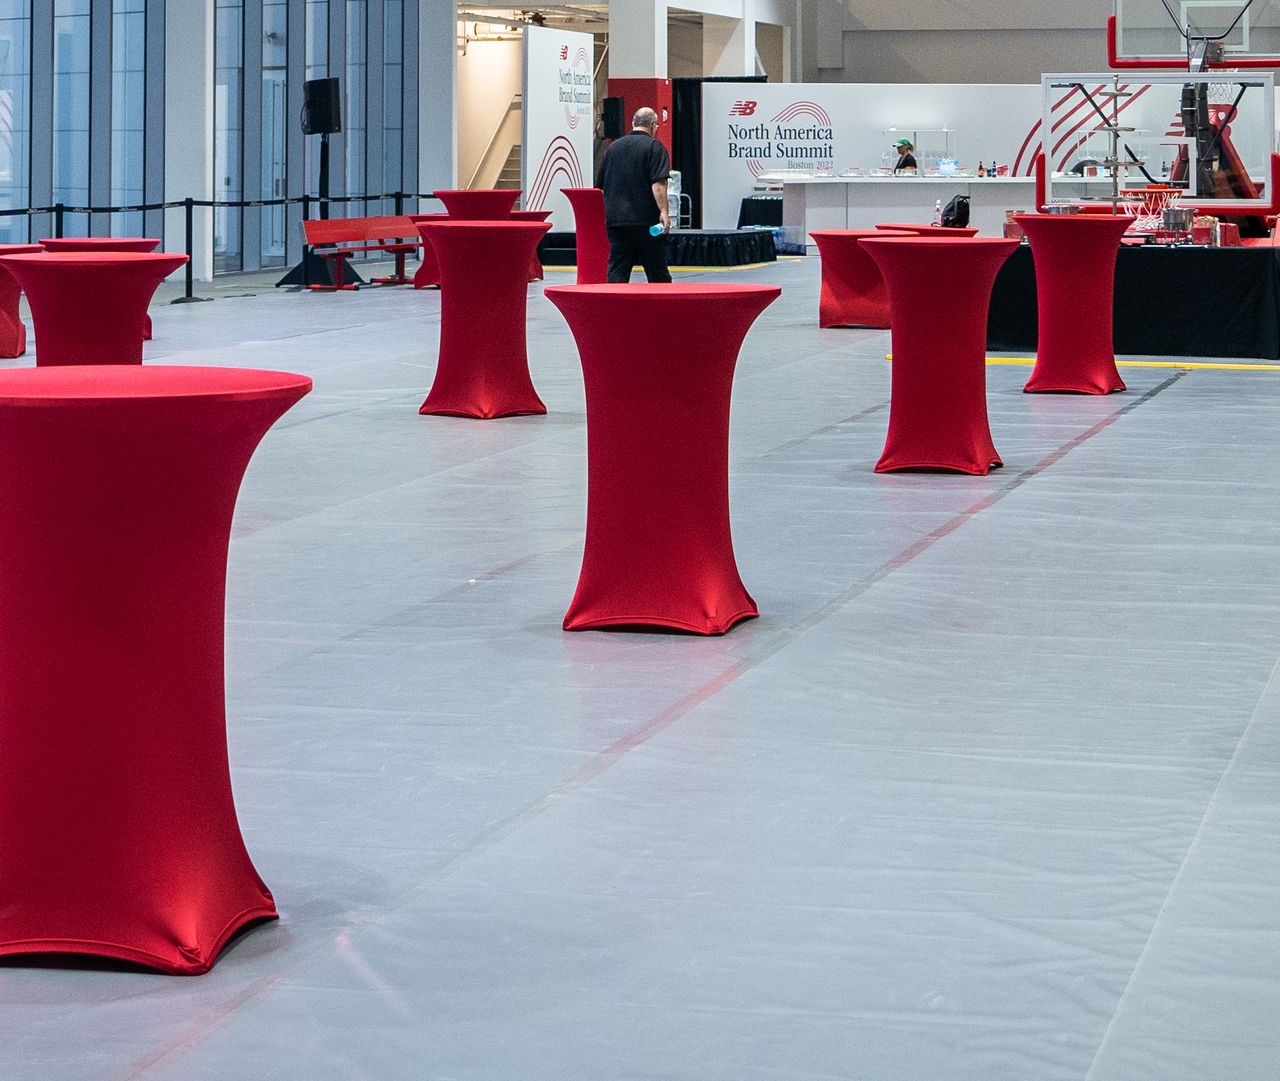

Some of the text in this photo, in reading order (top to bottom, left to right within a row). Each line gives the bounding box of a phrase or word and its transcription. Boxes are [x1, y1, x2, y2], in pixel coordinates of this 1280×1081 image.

[728, 123, 833, 140] North America
[728, 141, 834, 158] Brand Summit
[788, 159, 814, 169] Boston
